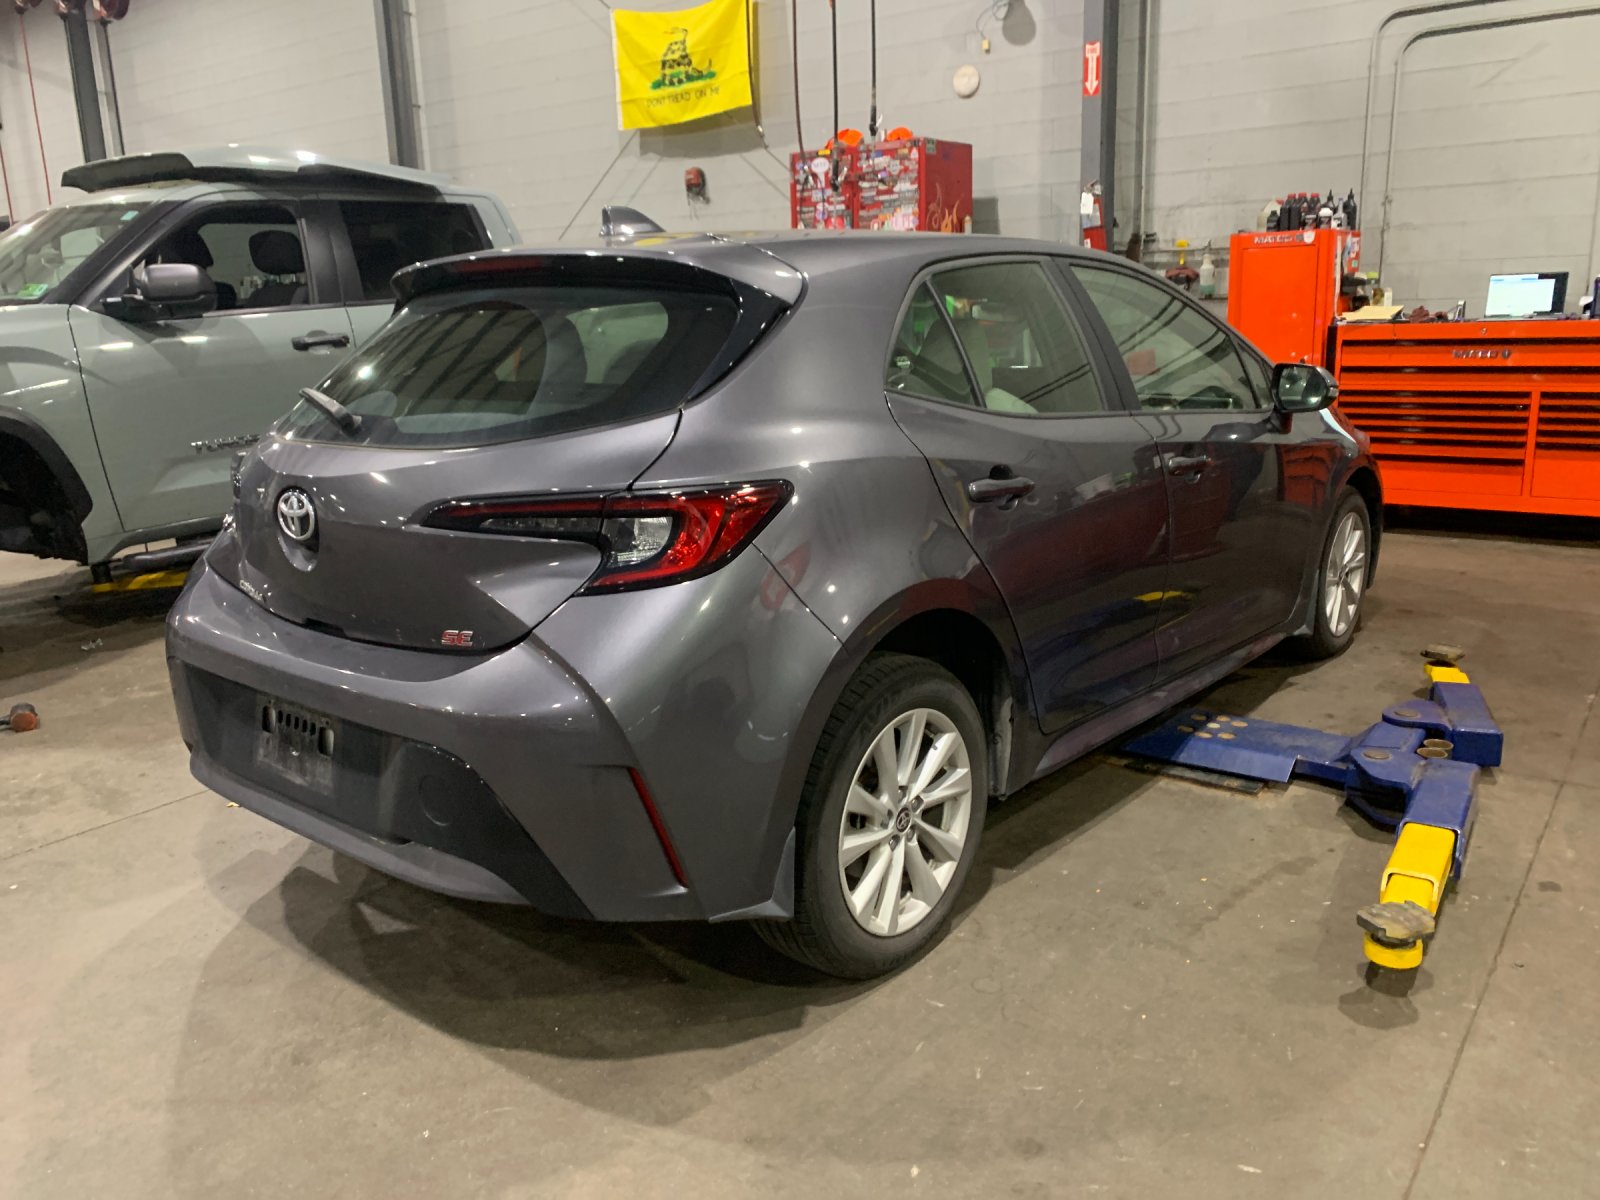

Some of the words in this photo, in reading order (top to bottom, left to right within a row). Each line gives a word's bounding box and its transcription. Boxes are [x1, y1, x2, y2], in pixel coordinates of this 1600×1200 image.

[667, 90, 691, 104] TREAD
[695, 88, 707, 100] ON
[441, 629, 473, 646] SE
